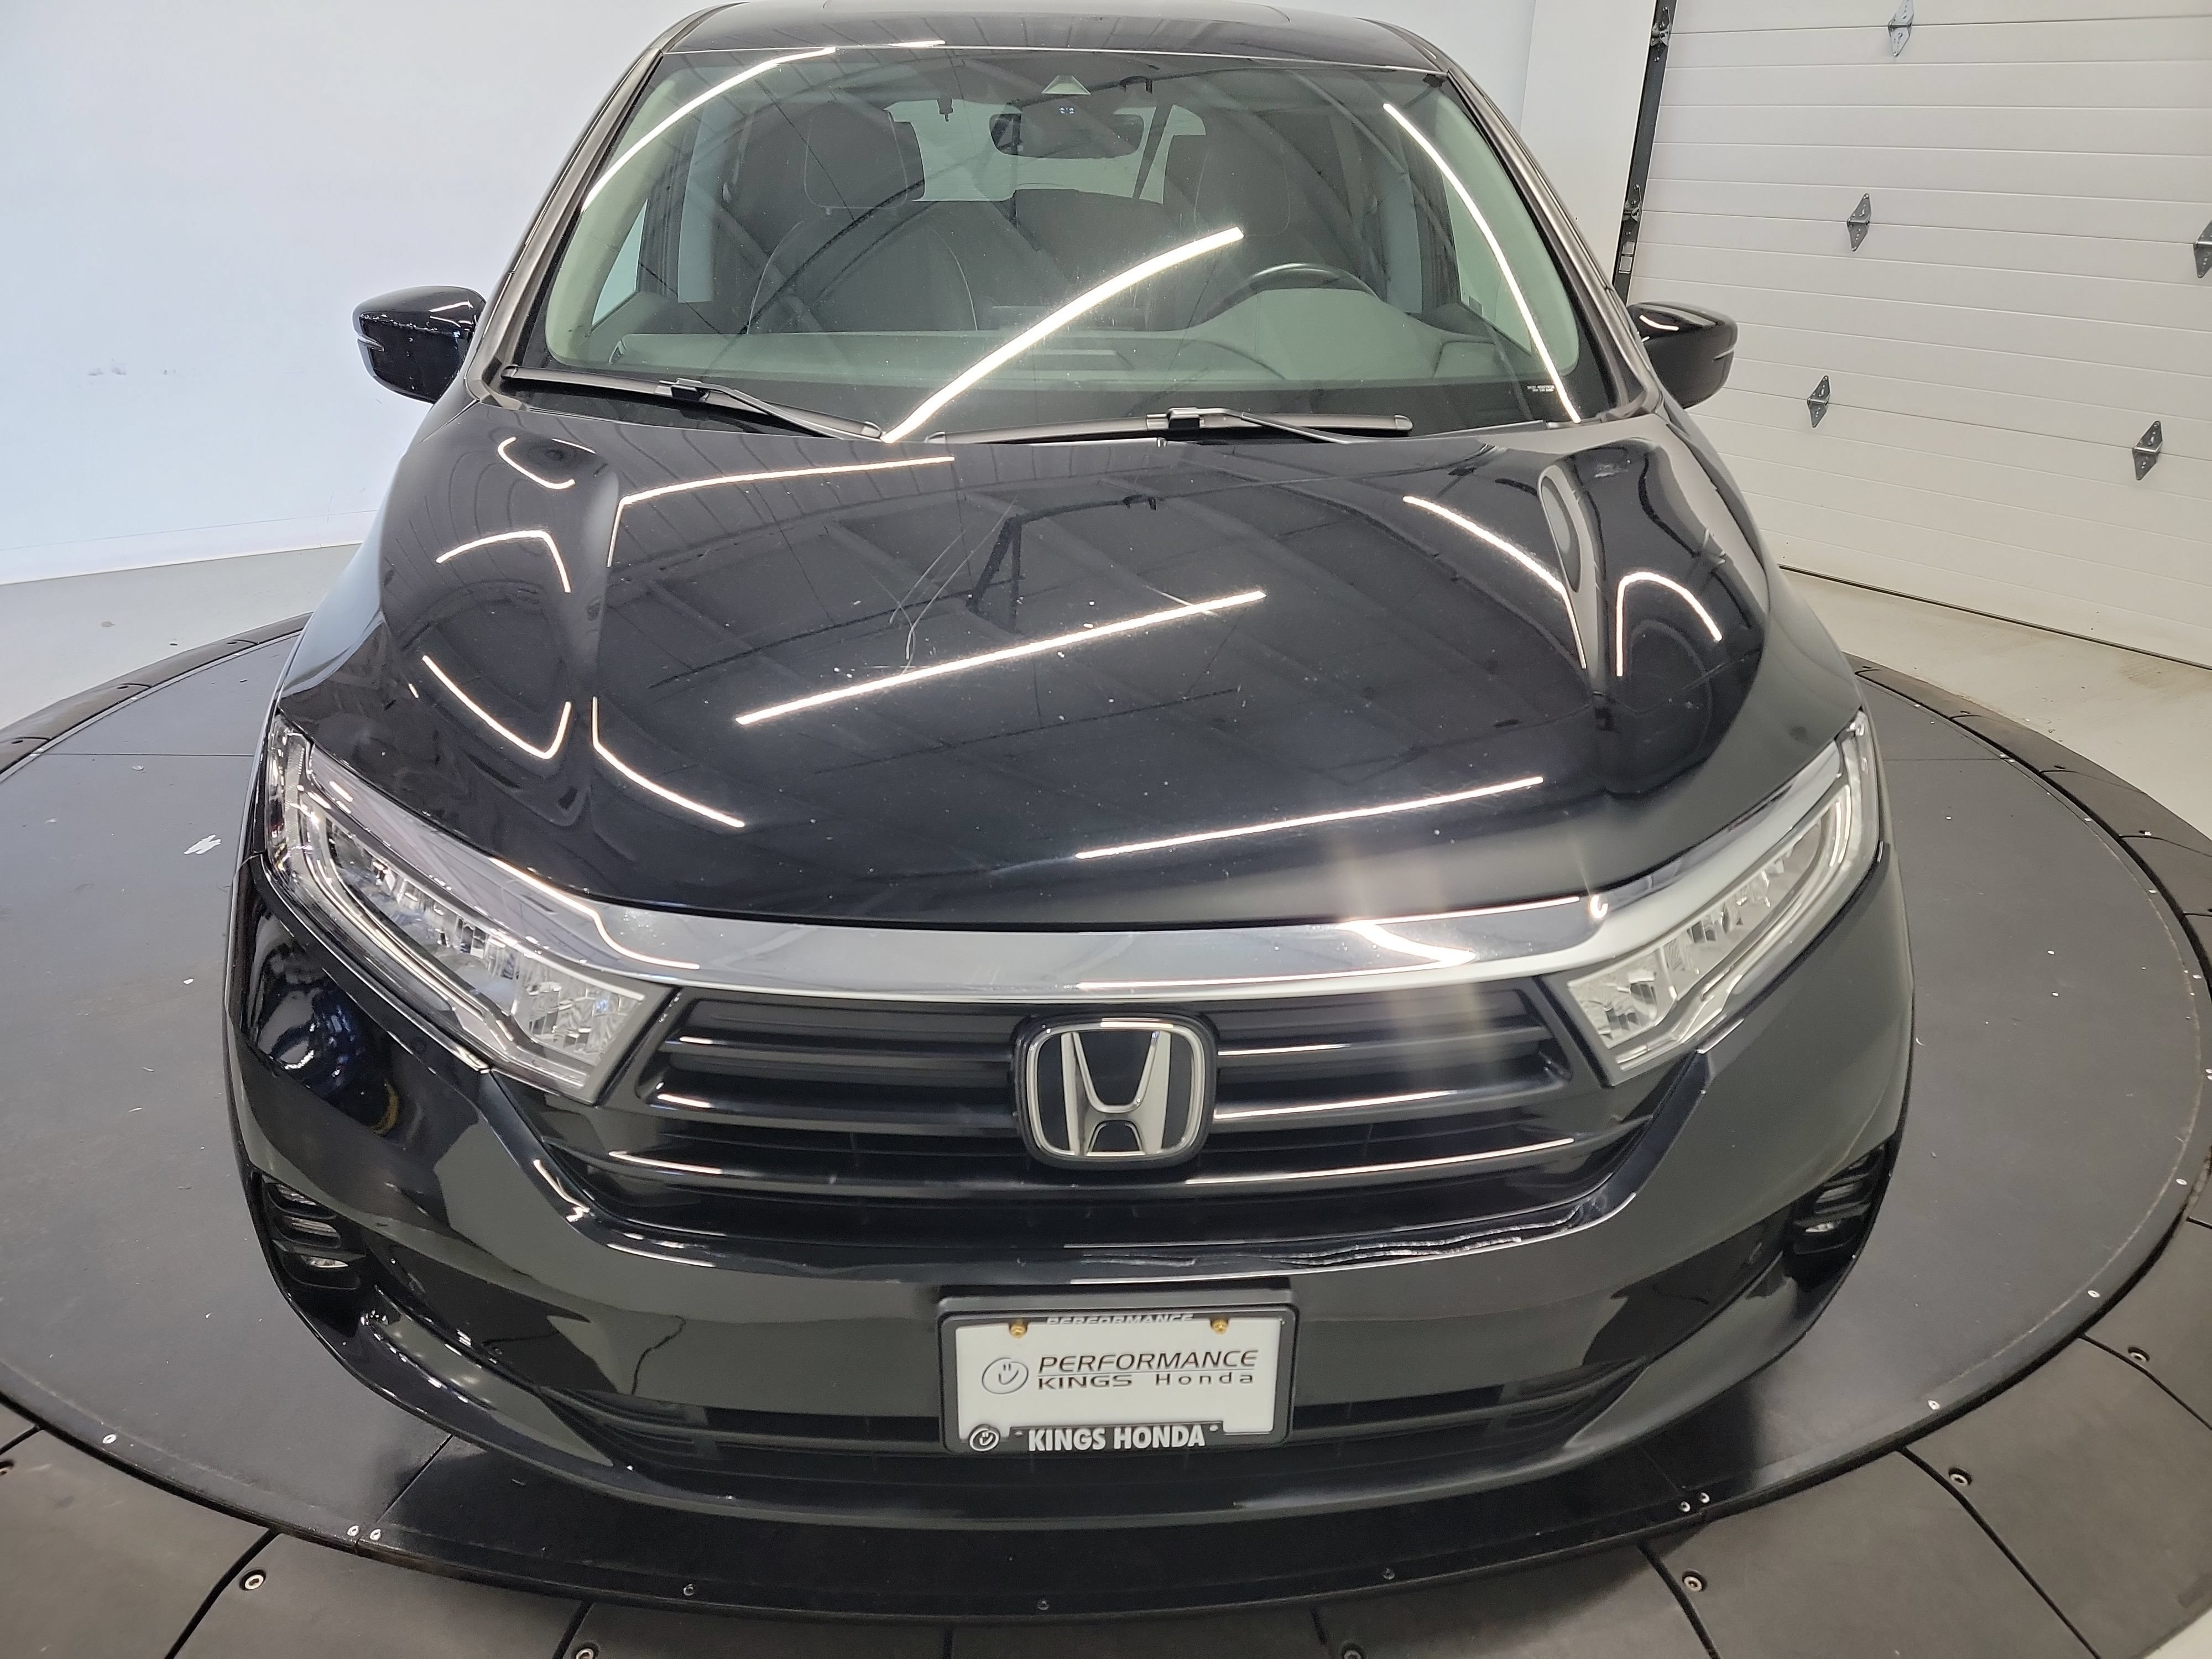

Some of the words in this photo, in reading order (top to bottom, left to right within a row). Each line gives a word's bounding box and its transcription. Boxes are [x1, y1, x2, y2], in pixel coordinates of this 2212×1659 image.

[1038, 1349, 1259, 1374] PERFORMANCE
[1037, 1374, 1133, 1390] KINGS
[1155, 1372, 1254, 1386] Honda
[1028, 1428, 1107, 1452] KINGS
[1113, 1424, 1206, 1449] HONDA
